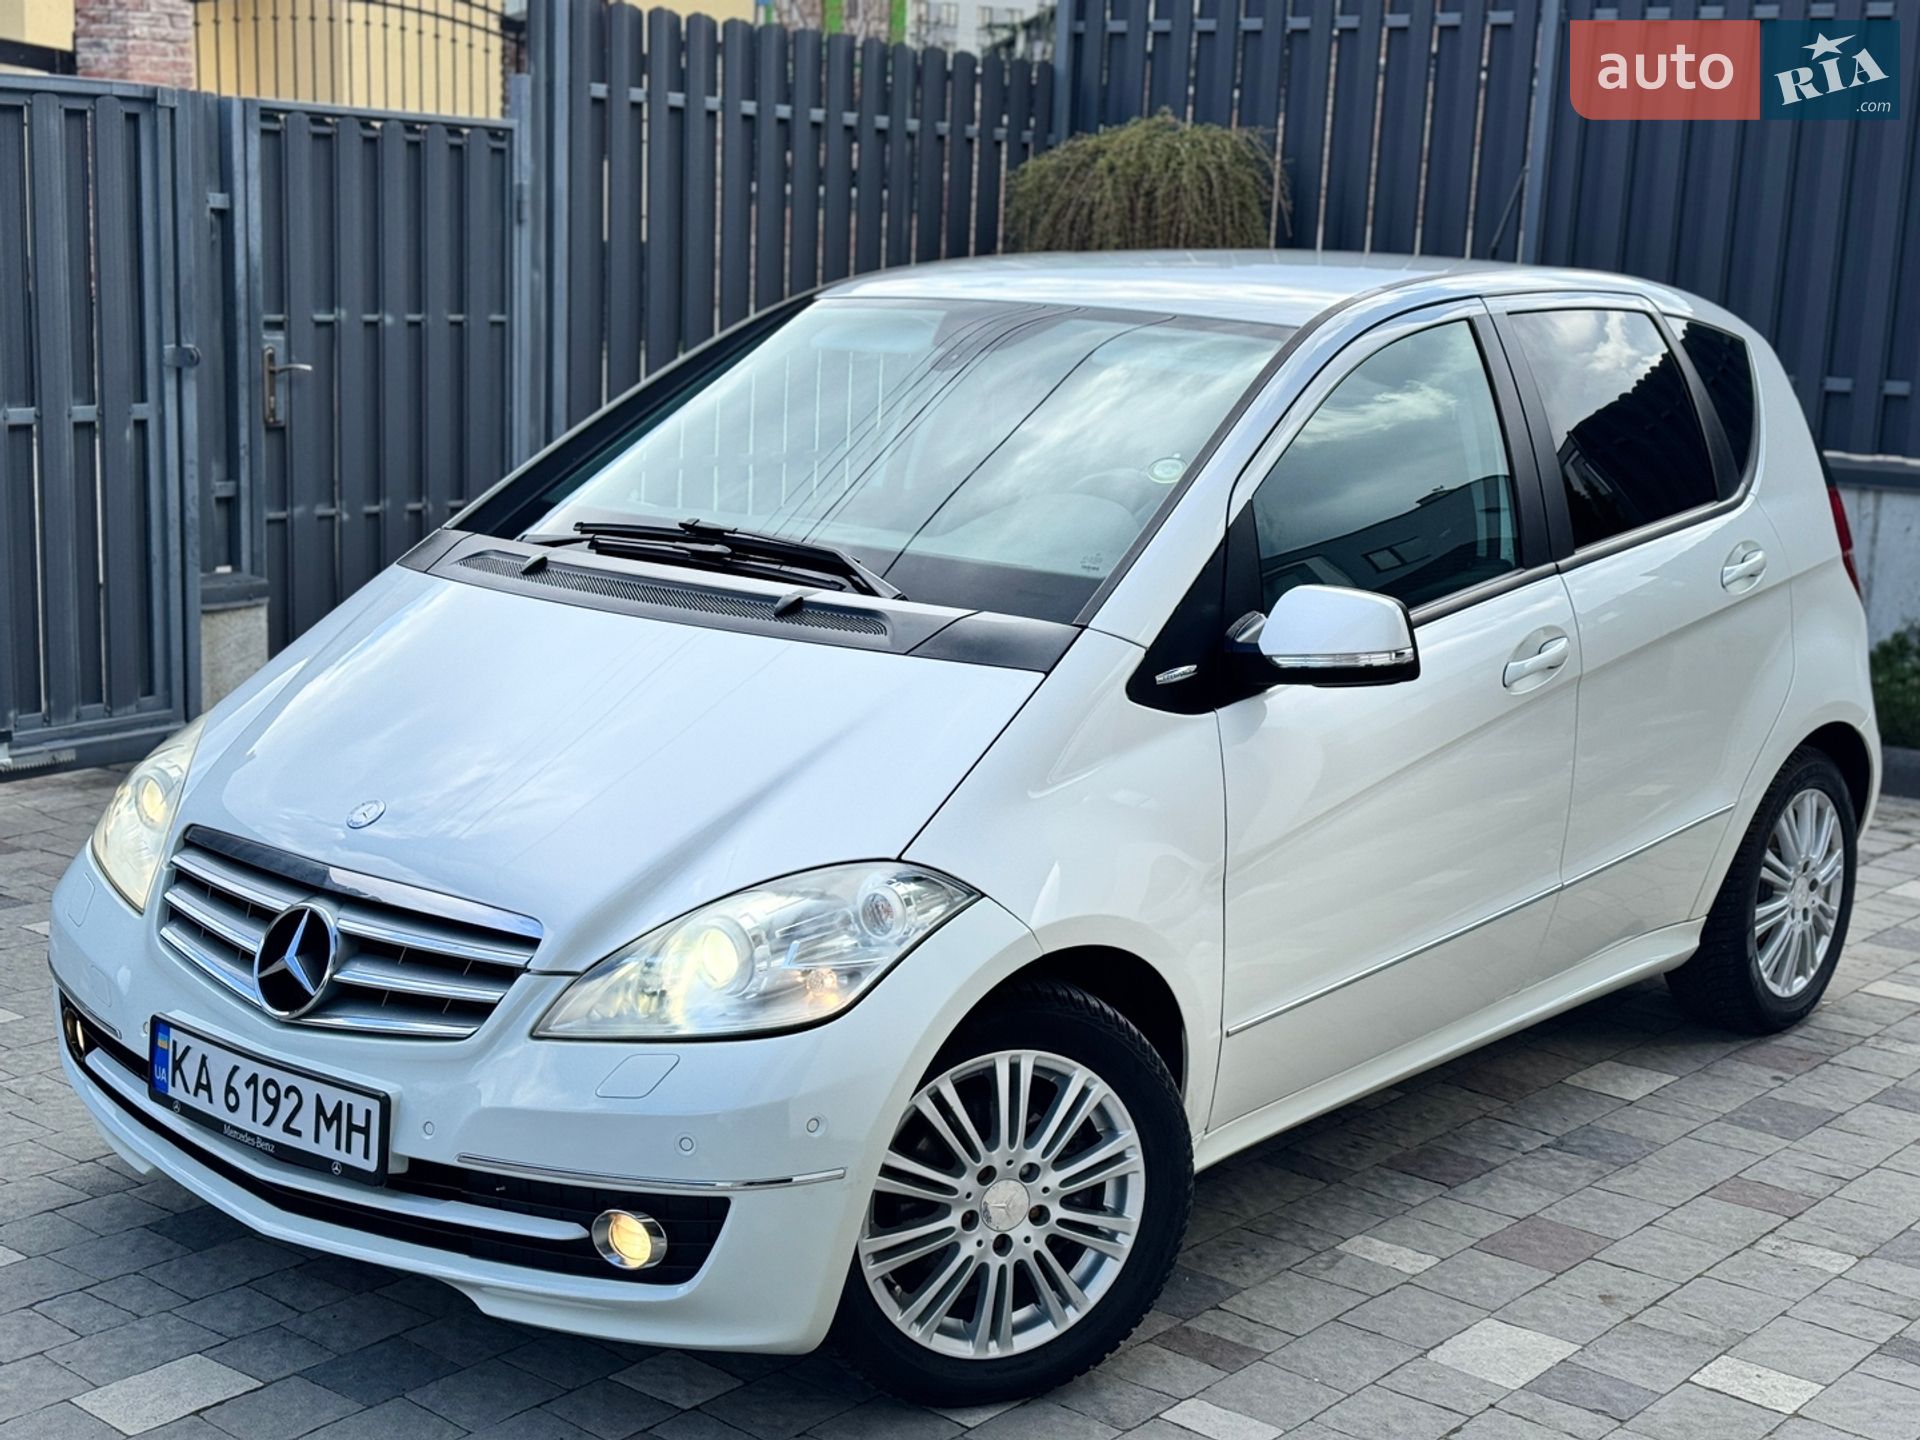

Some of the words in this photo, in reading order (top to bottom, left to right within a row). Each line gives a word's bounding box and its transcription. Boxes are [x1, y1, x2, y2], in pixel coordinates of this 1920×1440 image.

[155, 1067, 167, 1083] UA
[171, 1040, 213, 1104] KA
[224, 1065, 303, 1138] 6192
[314, 1093, 372, 1160] MH
[223, 1123, 275, 1153] Mercedes-Benz
